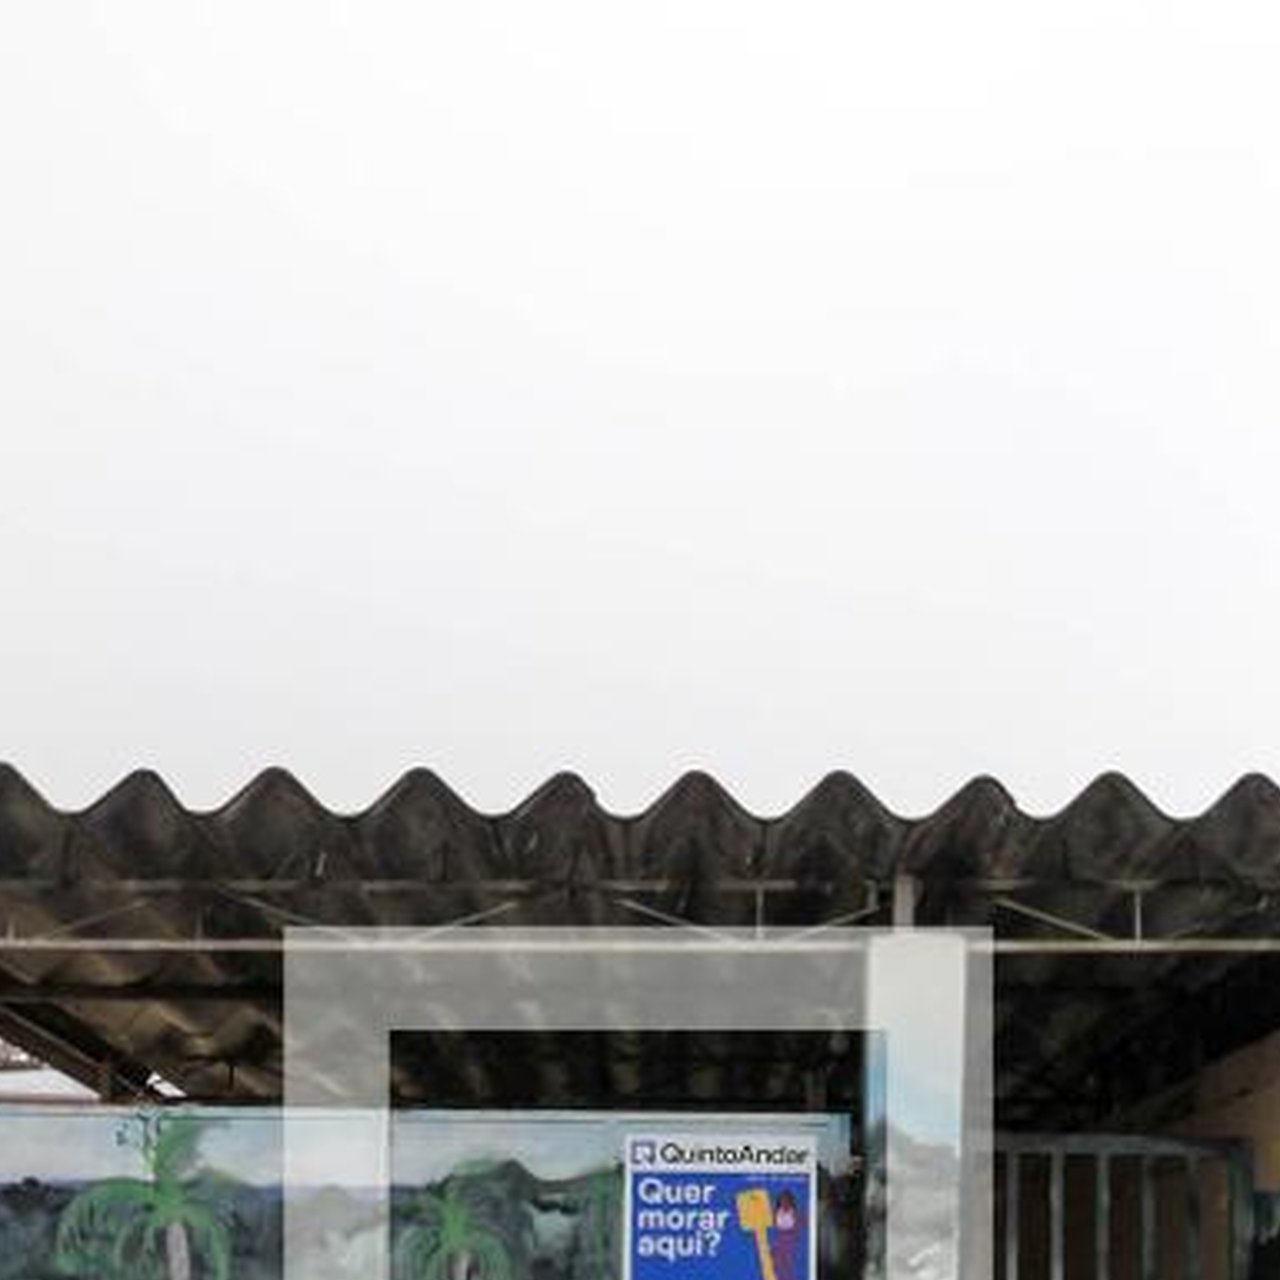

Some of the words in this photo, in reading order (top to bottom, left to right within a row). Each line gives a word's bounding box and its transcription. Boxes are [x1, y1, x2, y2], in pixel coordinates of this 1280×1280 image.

[660, 1142, 808, 1164] QuintoAndar
[638, 1178, 716, 1204] Quer
[638, 1208, 729, 1231] morar
[638, 1230, 721, 1262] aqui?
